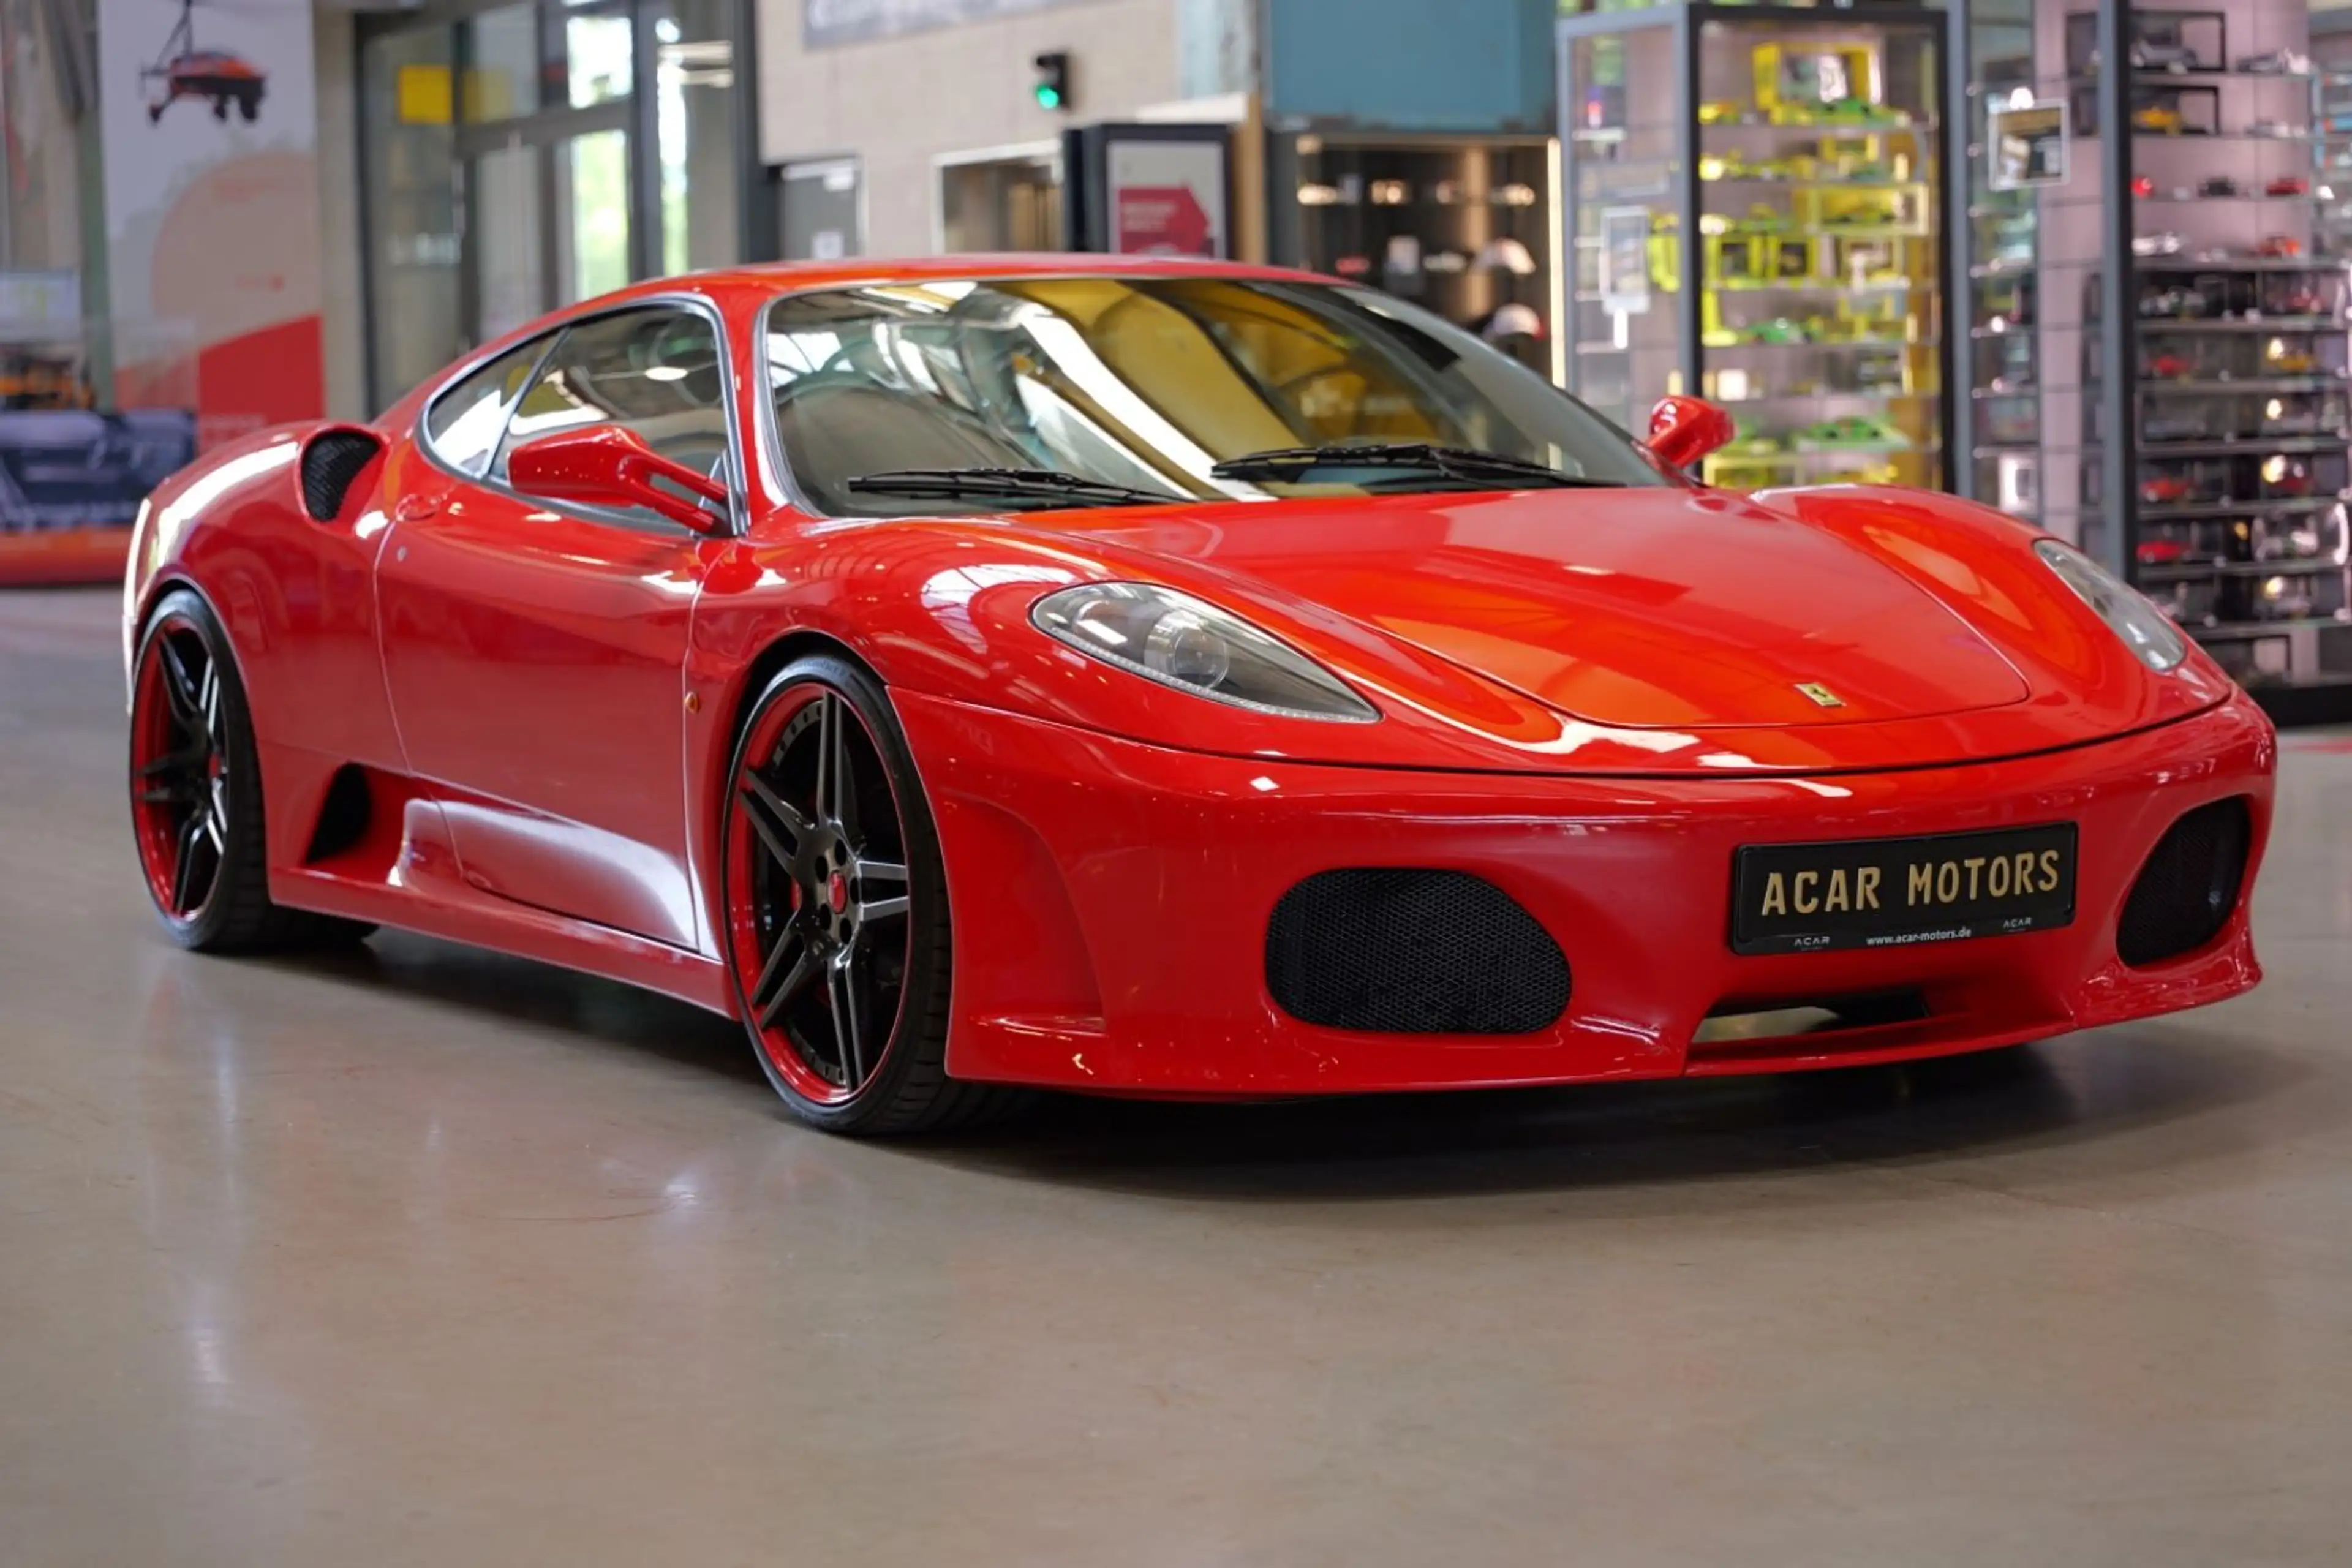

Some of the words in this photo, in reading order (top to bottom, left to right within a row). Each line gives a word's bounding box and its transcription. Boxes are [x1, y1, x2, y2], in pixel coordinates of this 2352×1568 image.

[1762, 867, 1881, 916] ACAR
[1908, 850, 2059, 907] MOTORS
[2003, 916, 2032, 929] ACAR
[1794, 936, 1830, 947] ACAR
[1866, 925, 1972, 946] www.acar-motors.de
